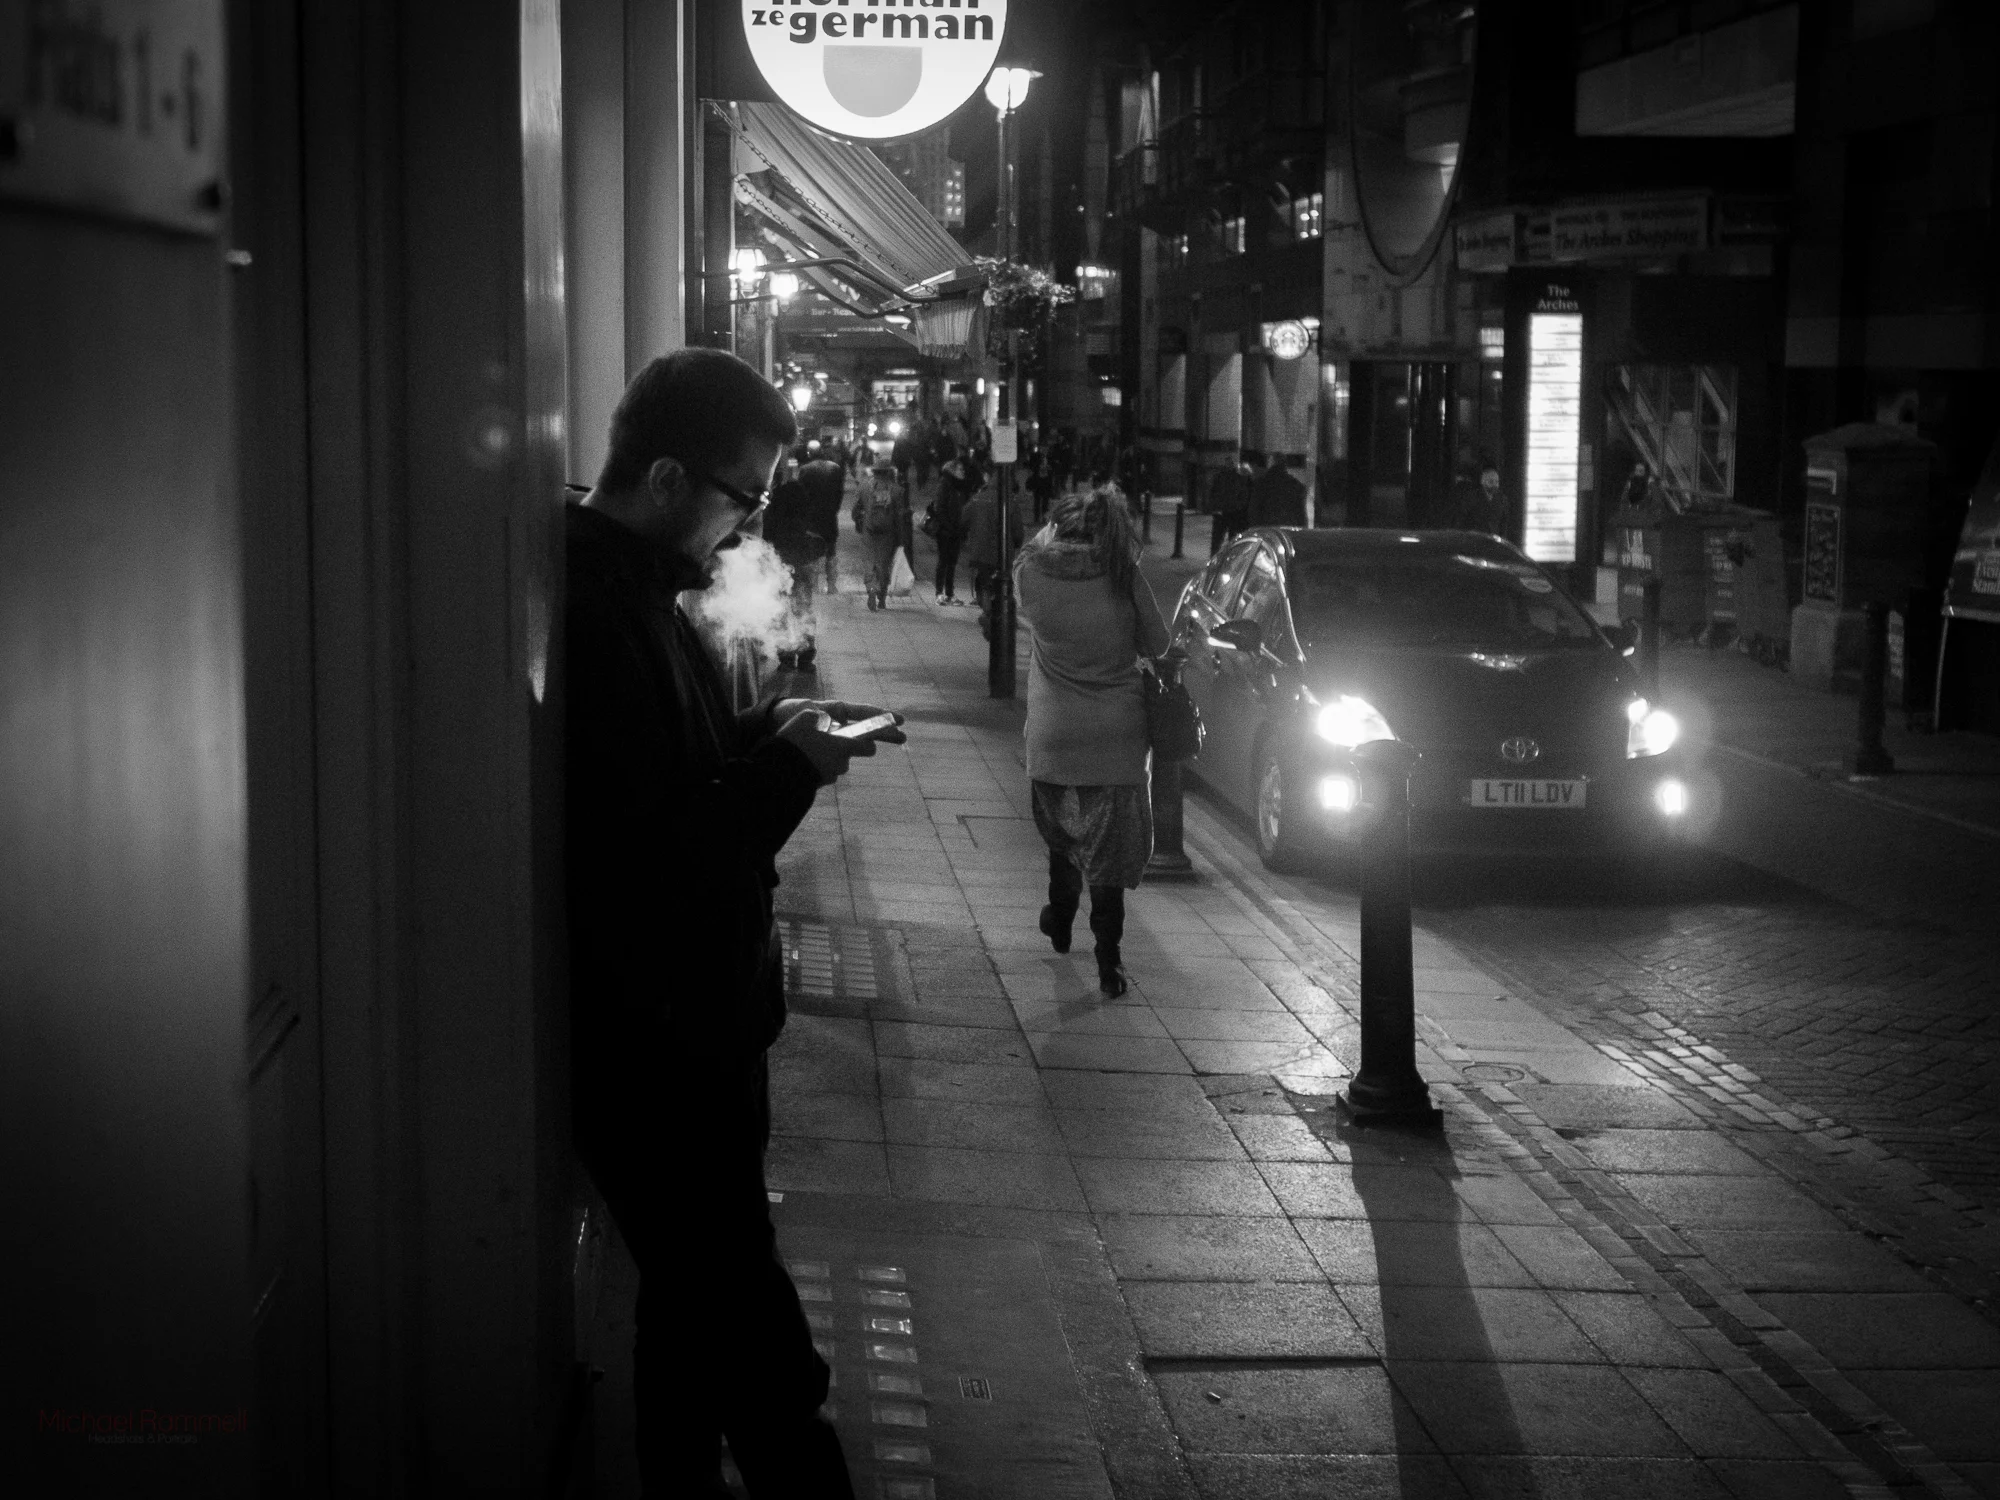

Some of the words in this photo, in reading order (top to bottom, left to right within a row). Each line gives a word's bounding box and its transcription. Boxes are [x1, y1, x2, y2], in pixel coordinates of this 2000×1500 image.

[752, 10, 784, 25] ze
[789, 12, 993, 44] german
[1548, 283, 1571, 297] The
[1537, 298, 1579, 311] Arches
